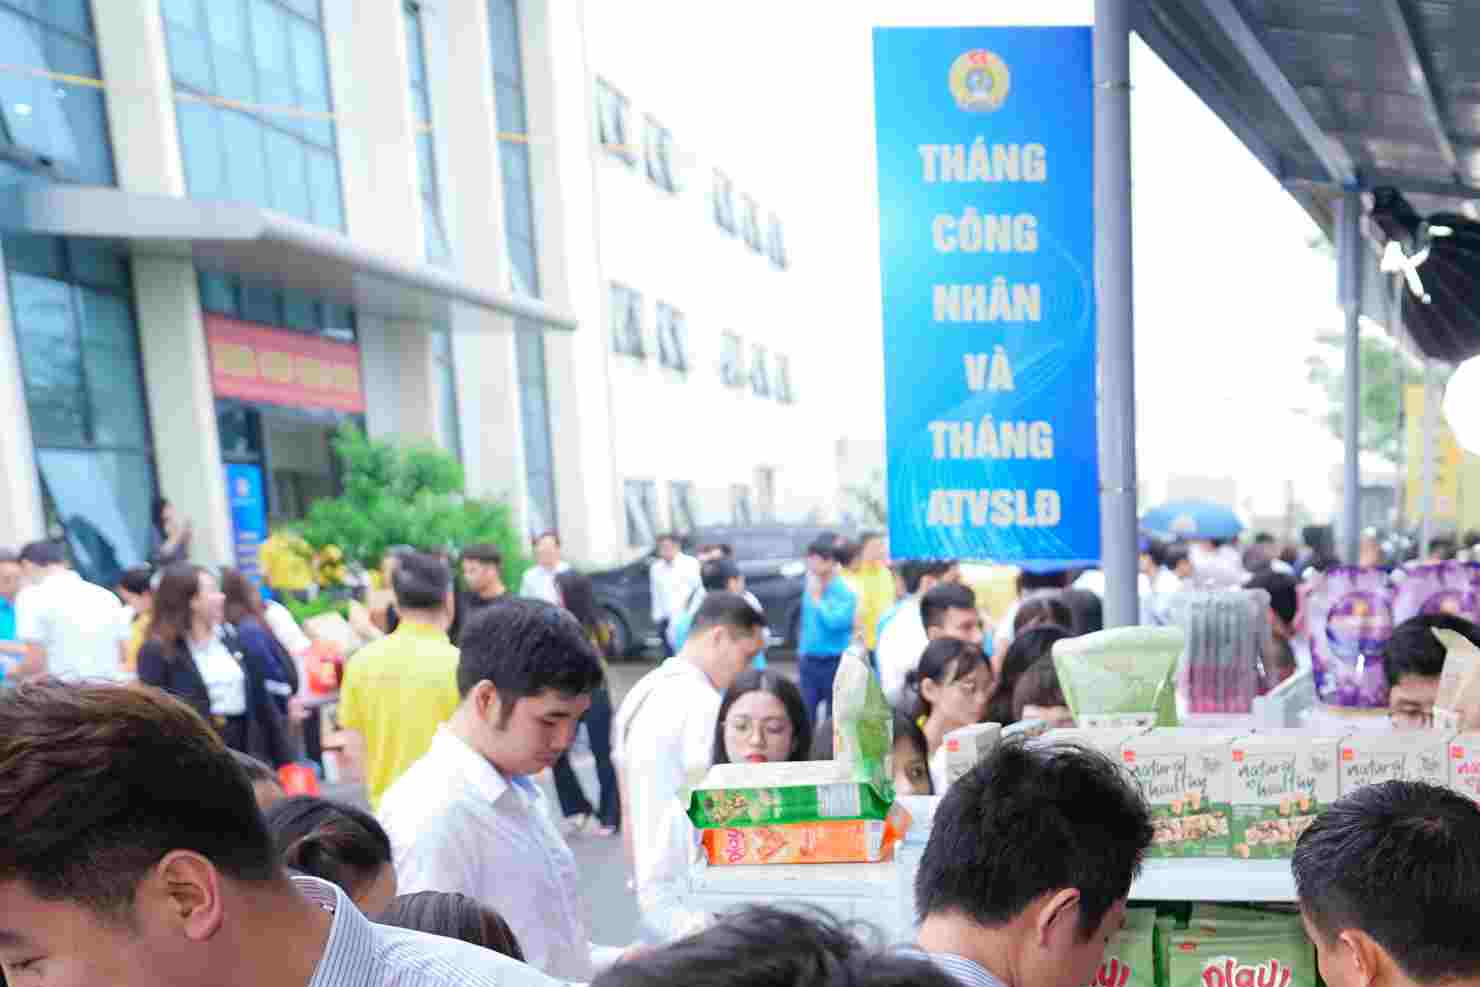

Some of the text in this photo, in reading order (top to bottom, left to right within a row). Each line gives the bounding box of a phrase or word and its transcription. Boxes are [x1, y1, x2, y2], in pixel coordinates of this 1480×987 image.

[918, 136, 1046, 183] THÁNG
[932, 206, 1039, 253] CÔNG
[932, 276, 1042, 323] NHÂN
[963, 346, 1015, 393] VÀ
[927, 413, 1054, 460] THÁNG
[927, 490, 1061, 528] ATVSLĐ
